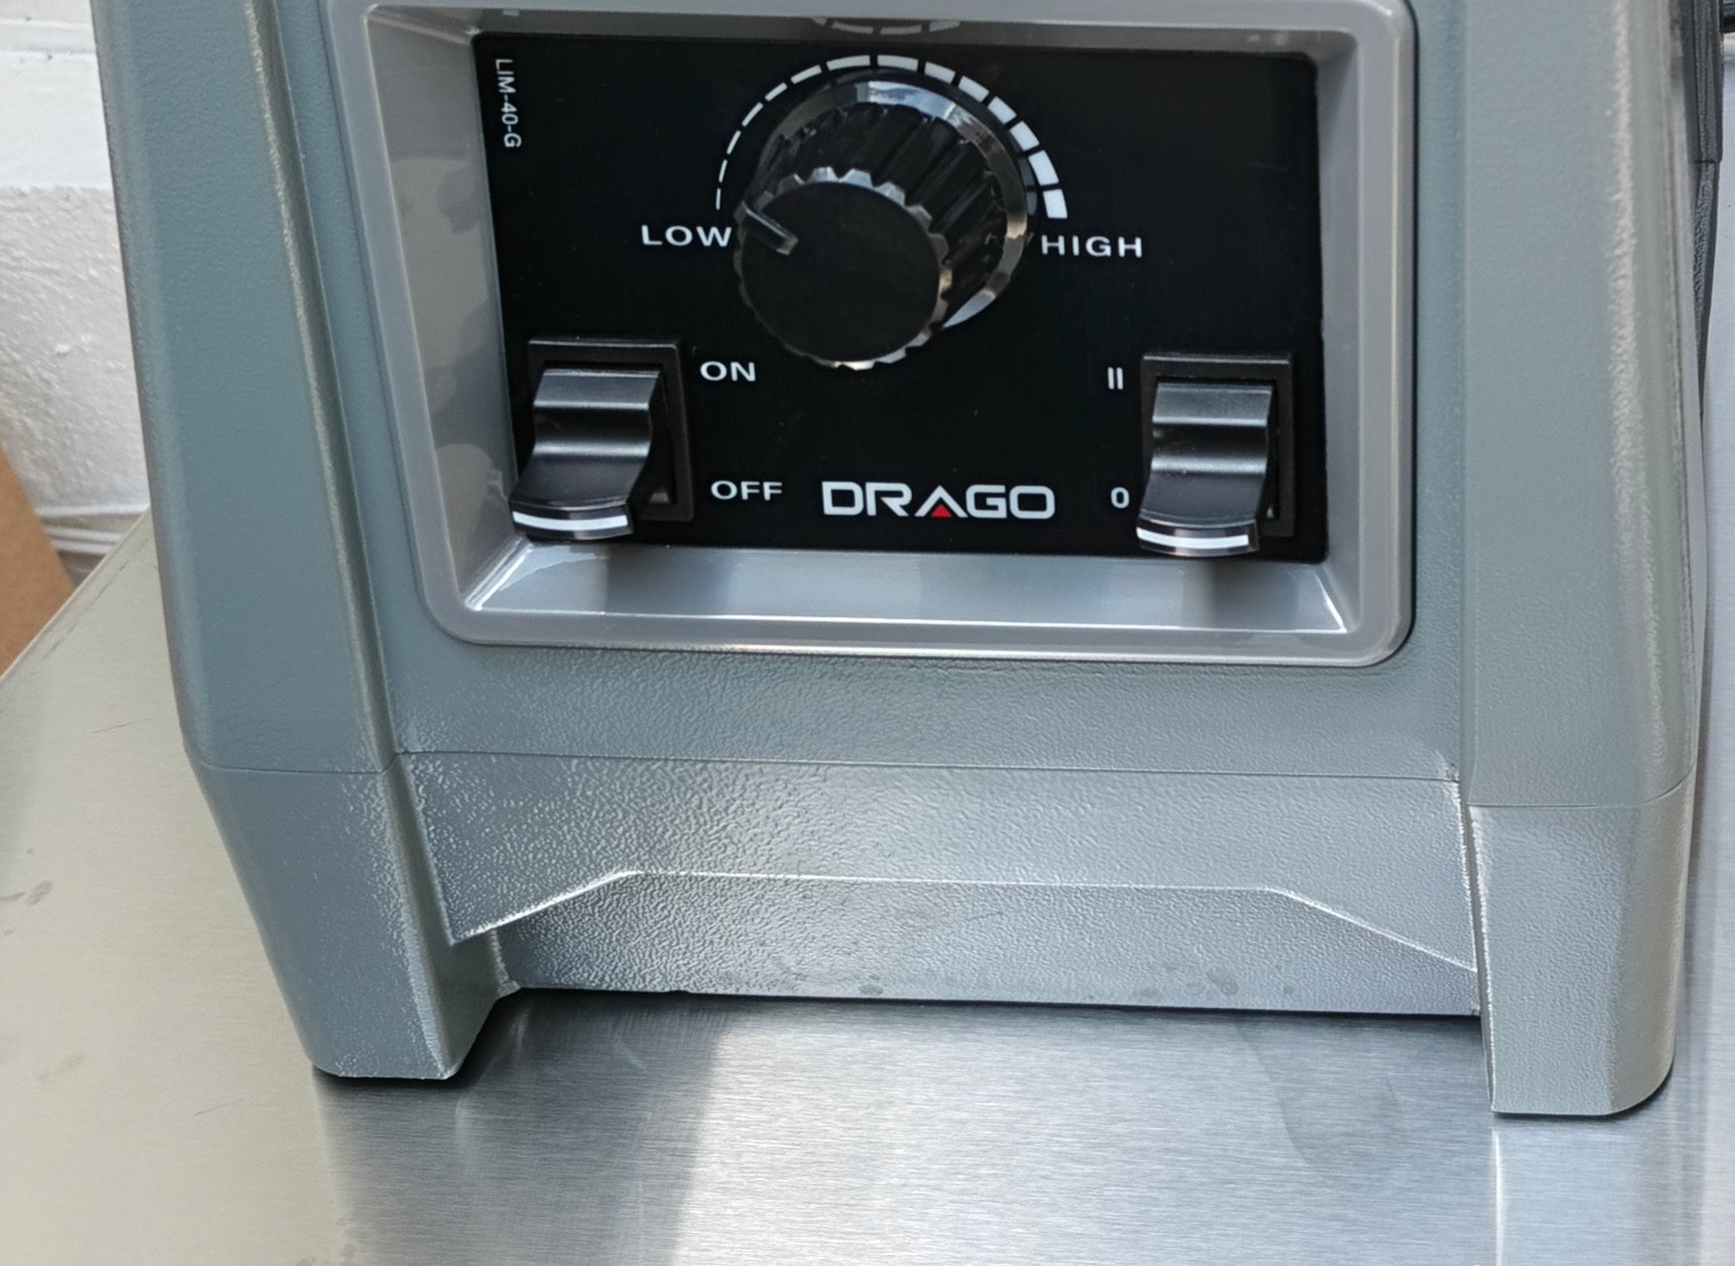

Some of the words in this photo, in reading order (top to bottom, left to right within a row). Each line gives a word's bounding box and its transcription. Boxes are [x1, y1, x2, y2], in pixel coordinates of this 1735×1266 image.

[496, 59, 522, 148] LIM-40-G
[640, 224, 732, 248] LOW
[1040, 234, 1143, 259] HIGH
[700, 361, 756, 382] ON
[711, 480, 782, 501] OFF
[821, 481, 1057, 520] DRAGO
